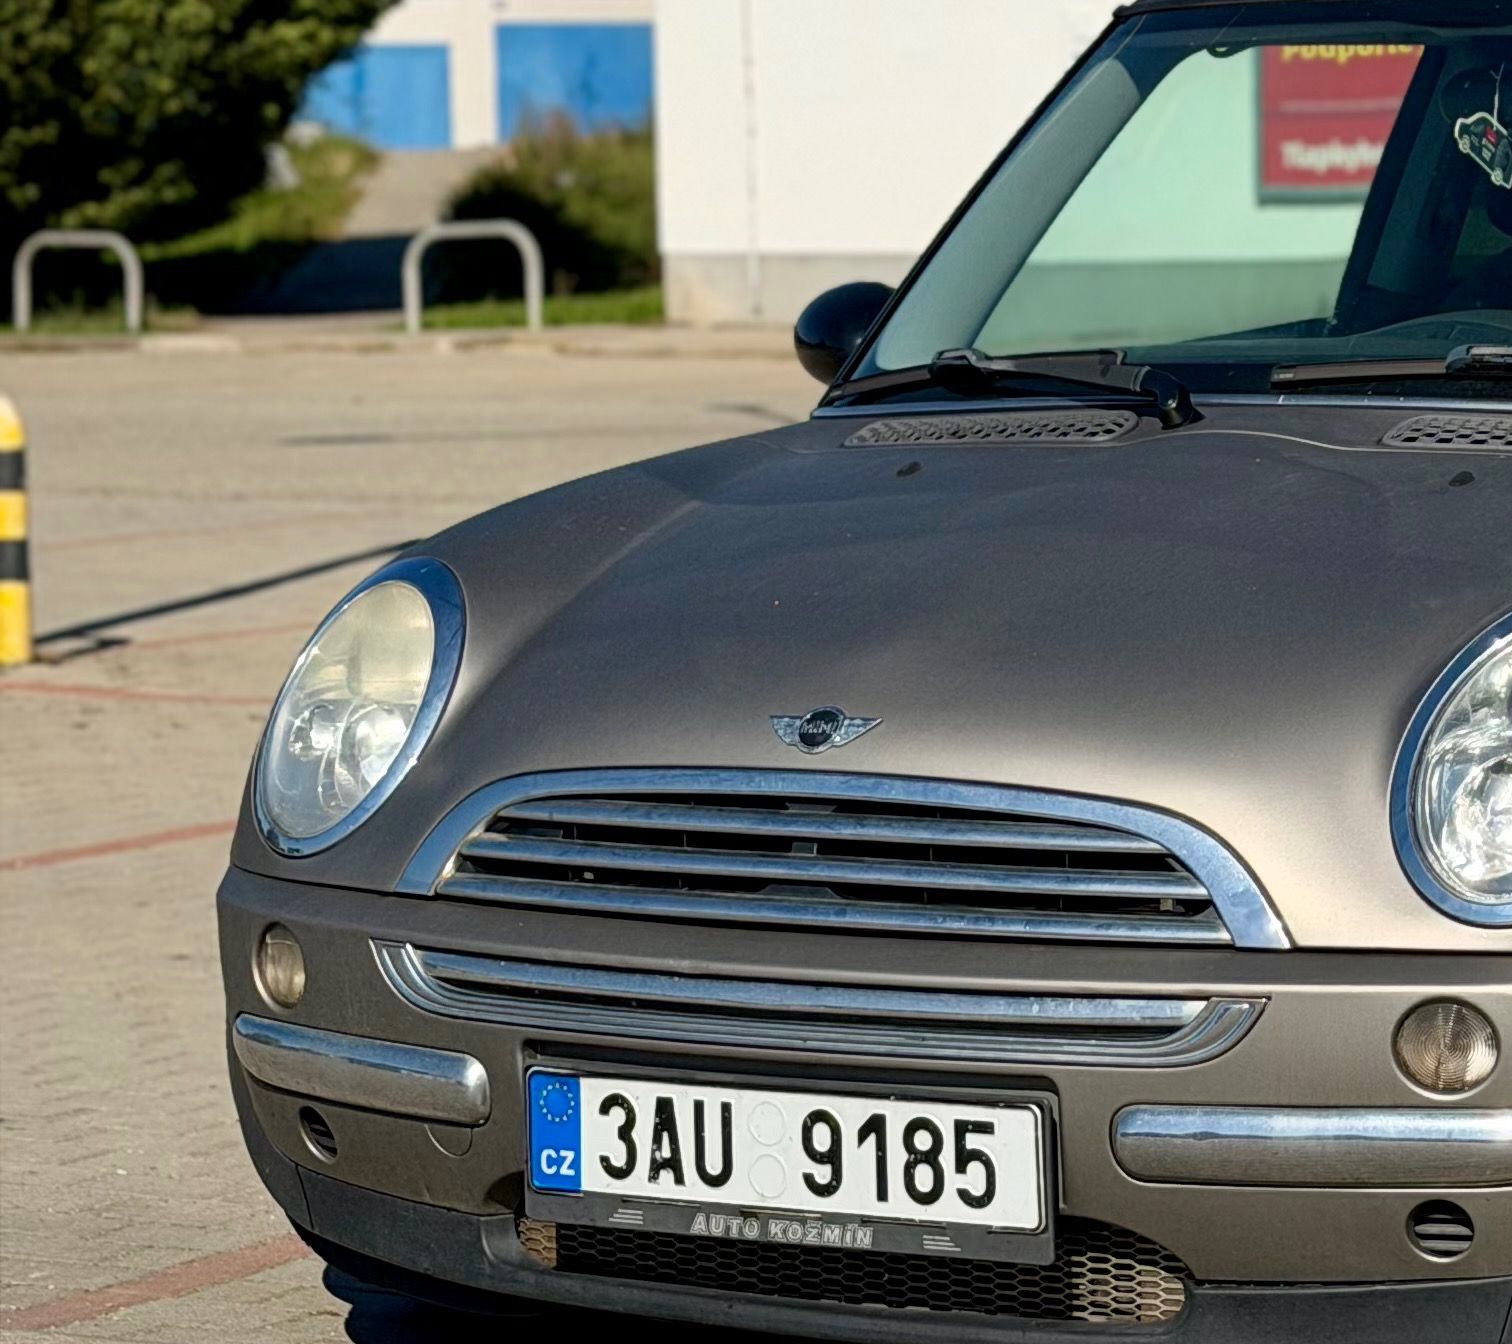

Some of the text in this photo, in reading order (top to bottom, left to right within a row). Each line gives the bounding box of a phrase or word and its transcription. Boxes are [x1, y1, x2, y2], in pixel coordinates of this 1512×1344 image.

[799, 719, 838, 735] MINI
[540, 1147, 577, 1177] CZ
[598, 1091, 997, 1210] 3AU 9185
[689, 1212, 875, 1249] AUTO KOŽMÍN
